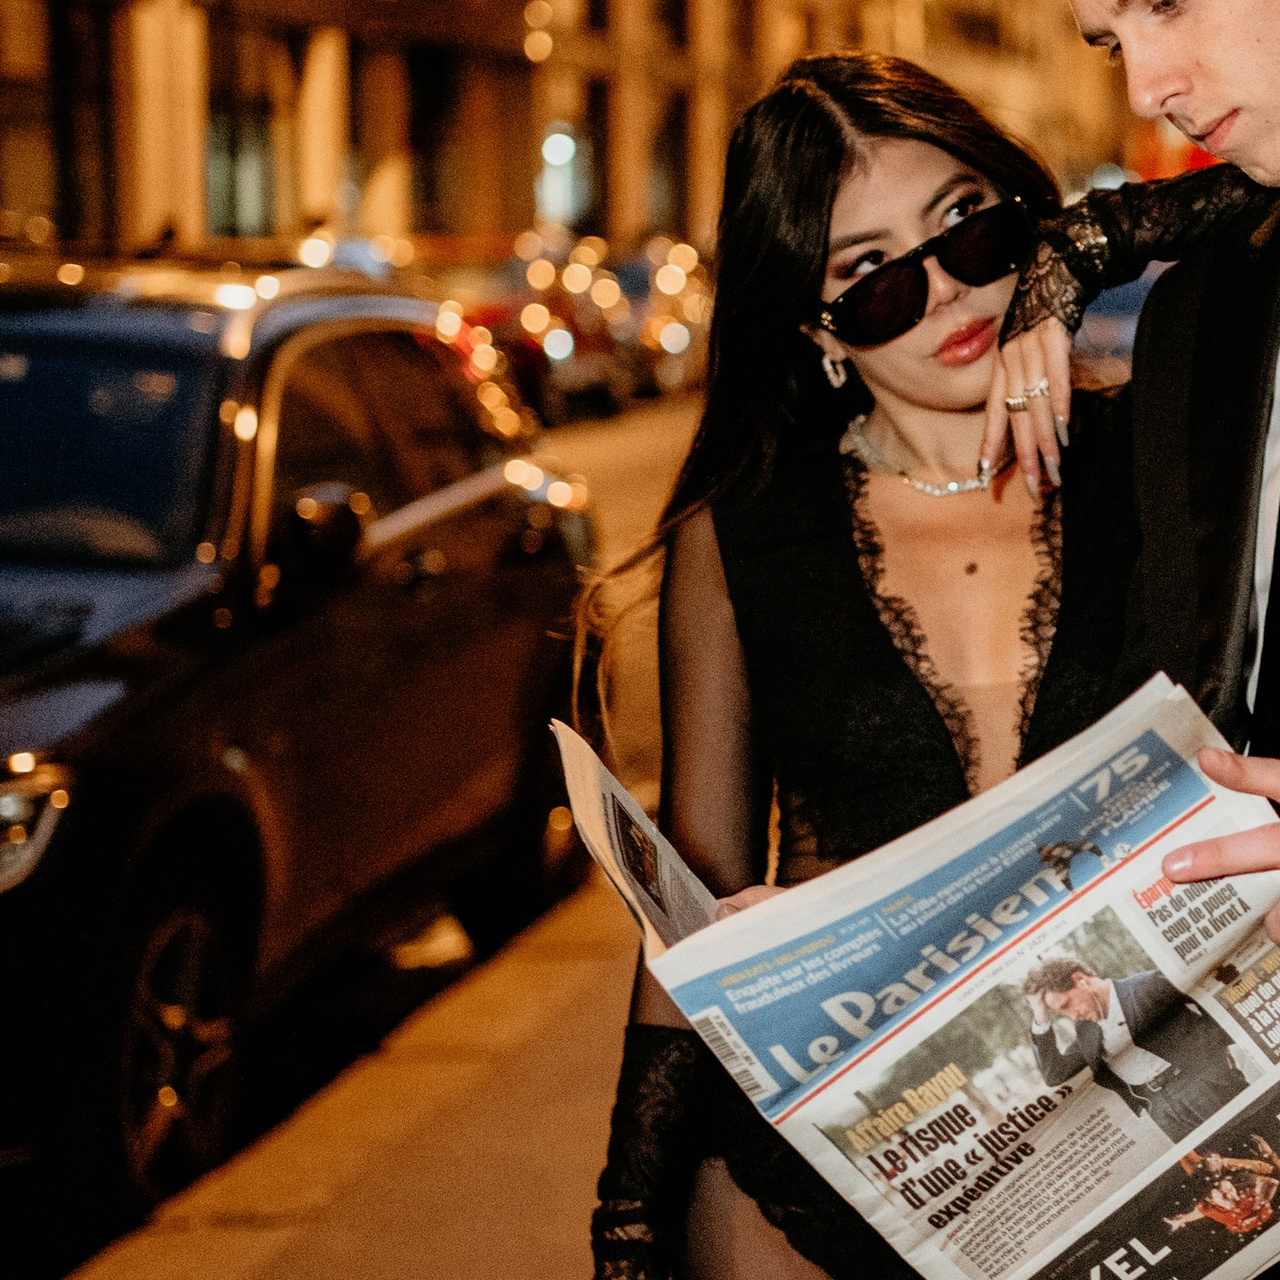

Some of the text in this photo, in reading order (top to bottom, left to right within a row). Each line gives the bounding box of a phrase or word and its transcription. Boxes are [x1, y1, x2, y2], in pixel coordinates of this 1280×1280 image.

[1077, 745, 1147, 803] 75
[888, 910, 910, 927] La
[903, 892, 938, 917] Ville
[897, 920, 918, 936] au
[915, 900, 947, 926] pied
[944, 890, 965, 905] de
[974, 865, 1003, 886] tour
[1130, 875, 1175, 909] Épargn
[1146, 900, 1173, 927] Pas
[1166, 890, 1188, 913] de
[1161, 882, 1238, 943] coup de pouce
[1173, 895, 1251, 959] pour le livret A
[723, 971, 783, 1002] Enquête
[779, 964, 804, 980] sur
[800, 955, 825, 970] les
[822, 927, 883, 962] comptes
[732, 979, 808, 1015] frauduleux
[804, 970, 832, 985] des
[828, 941, 881, 974] livreurs
[768, 1034, 845, 1083] Le
[819, 867, 1065, 1040] Parisien
[1233, 990, 1264, 1018] Duel
[1255, 979, 1277, 1001] de
[1246, 1013, 1263, 1033] à
[1253, 1005, 1274, 1028] la
[845, 1061, 968, 1153] Affaire Bayou
[867, 1101, 978, 1181] Le risque
[900, 1156, 968, 1210] d'une
[973, 1092, 1058, 1161] justice
[927, 1140, 1036, 1230] expéditive
